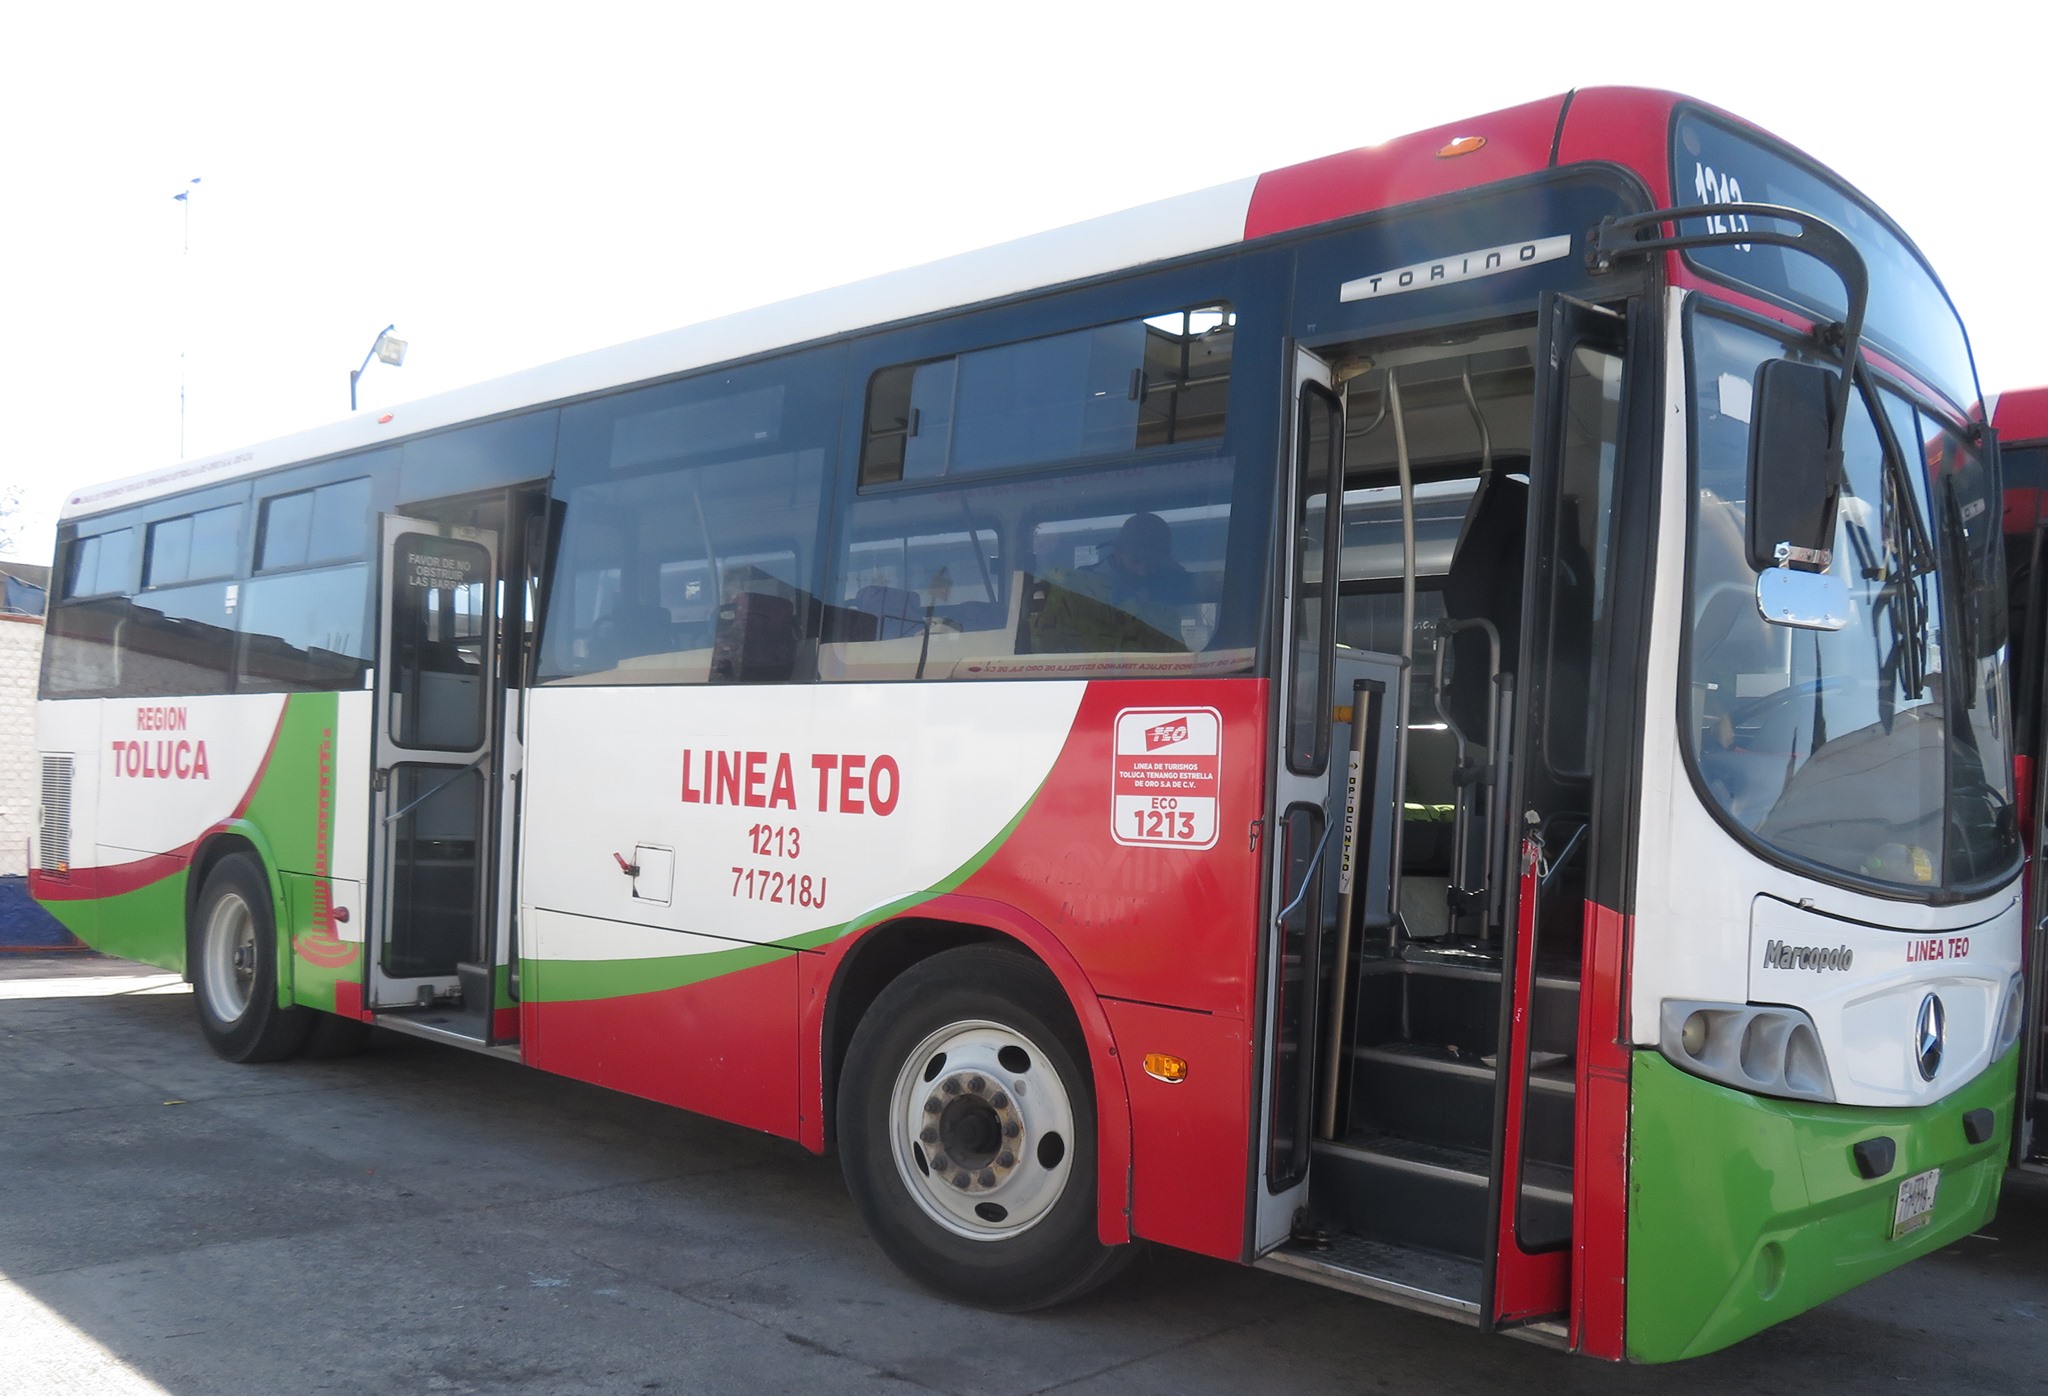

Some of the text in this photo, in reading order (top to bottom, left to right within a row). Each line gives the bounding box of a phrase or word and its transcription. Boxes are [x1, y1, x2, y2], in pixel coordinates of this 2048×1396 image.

[1370, 245, 1536, 293] TORINO
[409, 553, 471, 571] FAVOR DE NO
[416, 565, 464, 581] OBSTRUIR
[409, 575, 428, 587] LAS
[137, 706, 187, 731] REGION
[1152, 725, 1187, 742] TEO
[112, 740, 210, 780] TOLUCA
[1165, 763, 1198, 771] TURISMOS
[681, 749, 900, 817] LINEA TEO
[1120, 771, 1145, 779] TOLUCA
[1180, 772, 1213, 780] ESTRELLA
[1151, 797, 1178, 809] ECO
[1134, 810, 1195, 839] 1213
[748, 823, 801, 859] 1213
[732, 867, 827, 909] 717218J
[1763, 939, 1853, 973] Marcopolo
[1906, 937, 1970, 962] LINEA TEO
